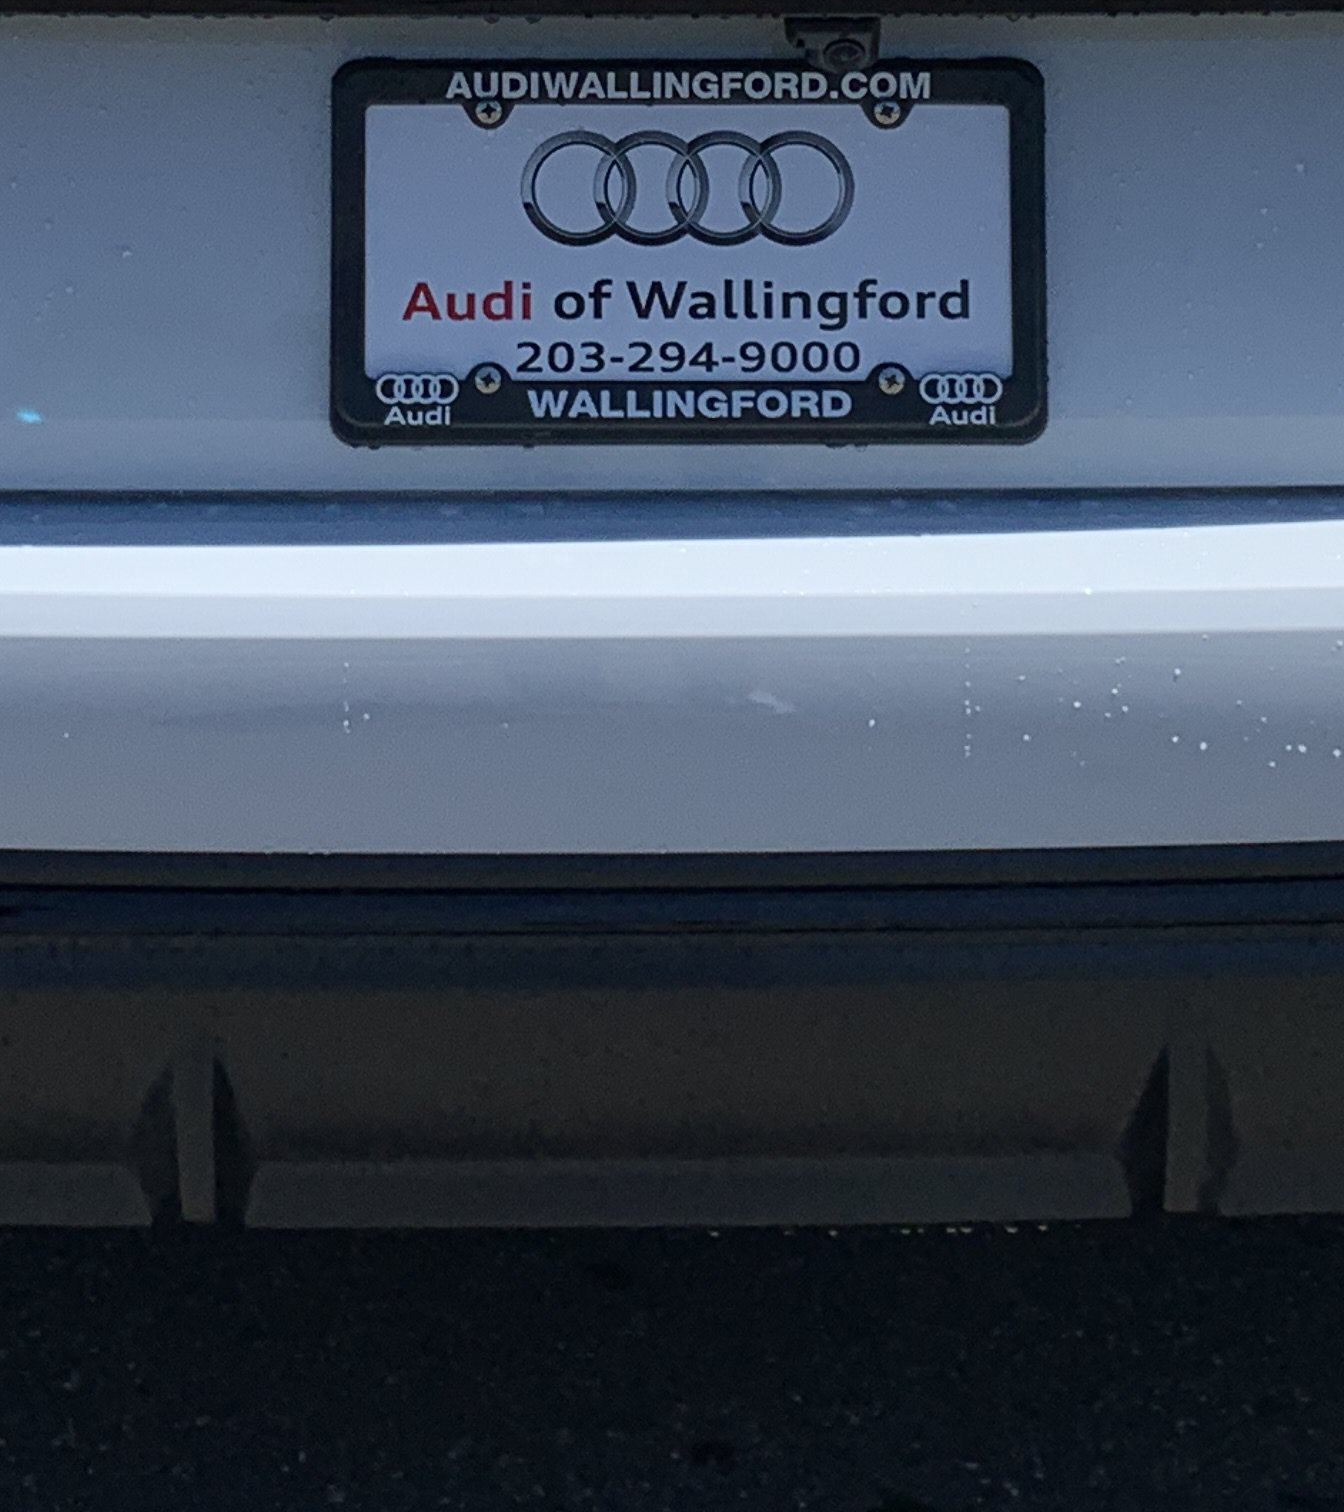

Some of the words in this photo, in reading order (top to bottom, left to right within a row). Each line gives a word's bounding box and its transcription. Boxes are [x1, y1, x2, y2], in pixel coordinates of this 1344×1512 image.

[445, 71, 931, 100] AUDIWALLINGFORD.COM
[402, 280, 534, 322] Audi
[553, 279, 613, 322] of
[626, 279, 972, 331] Wallingford
[514, 340, 862, 374] 203-294-9000
[384, 404, 452, 426] Audi
[527, 389, 854, 419] WALLINGFORD
[928, 403, 997, 425] Audi
